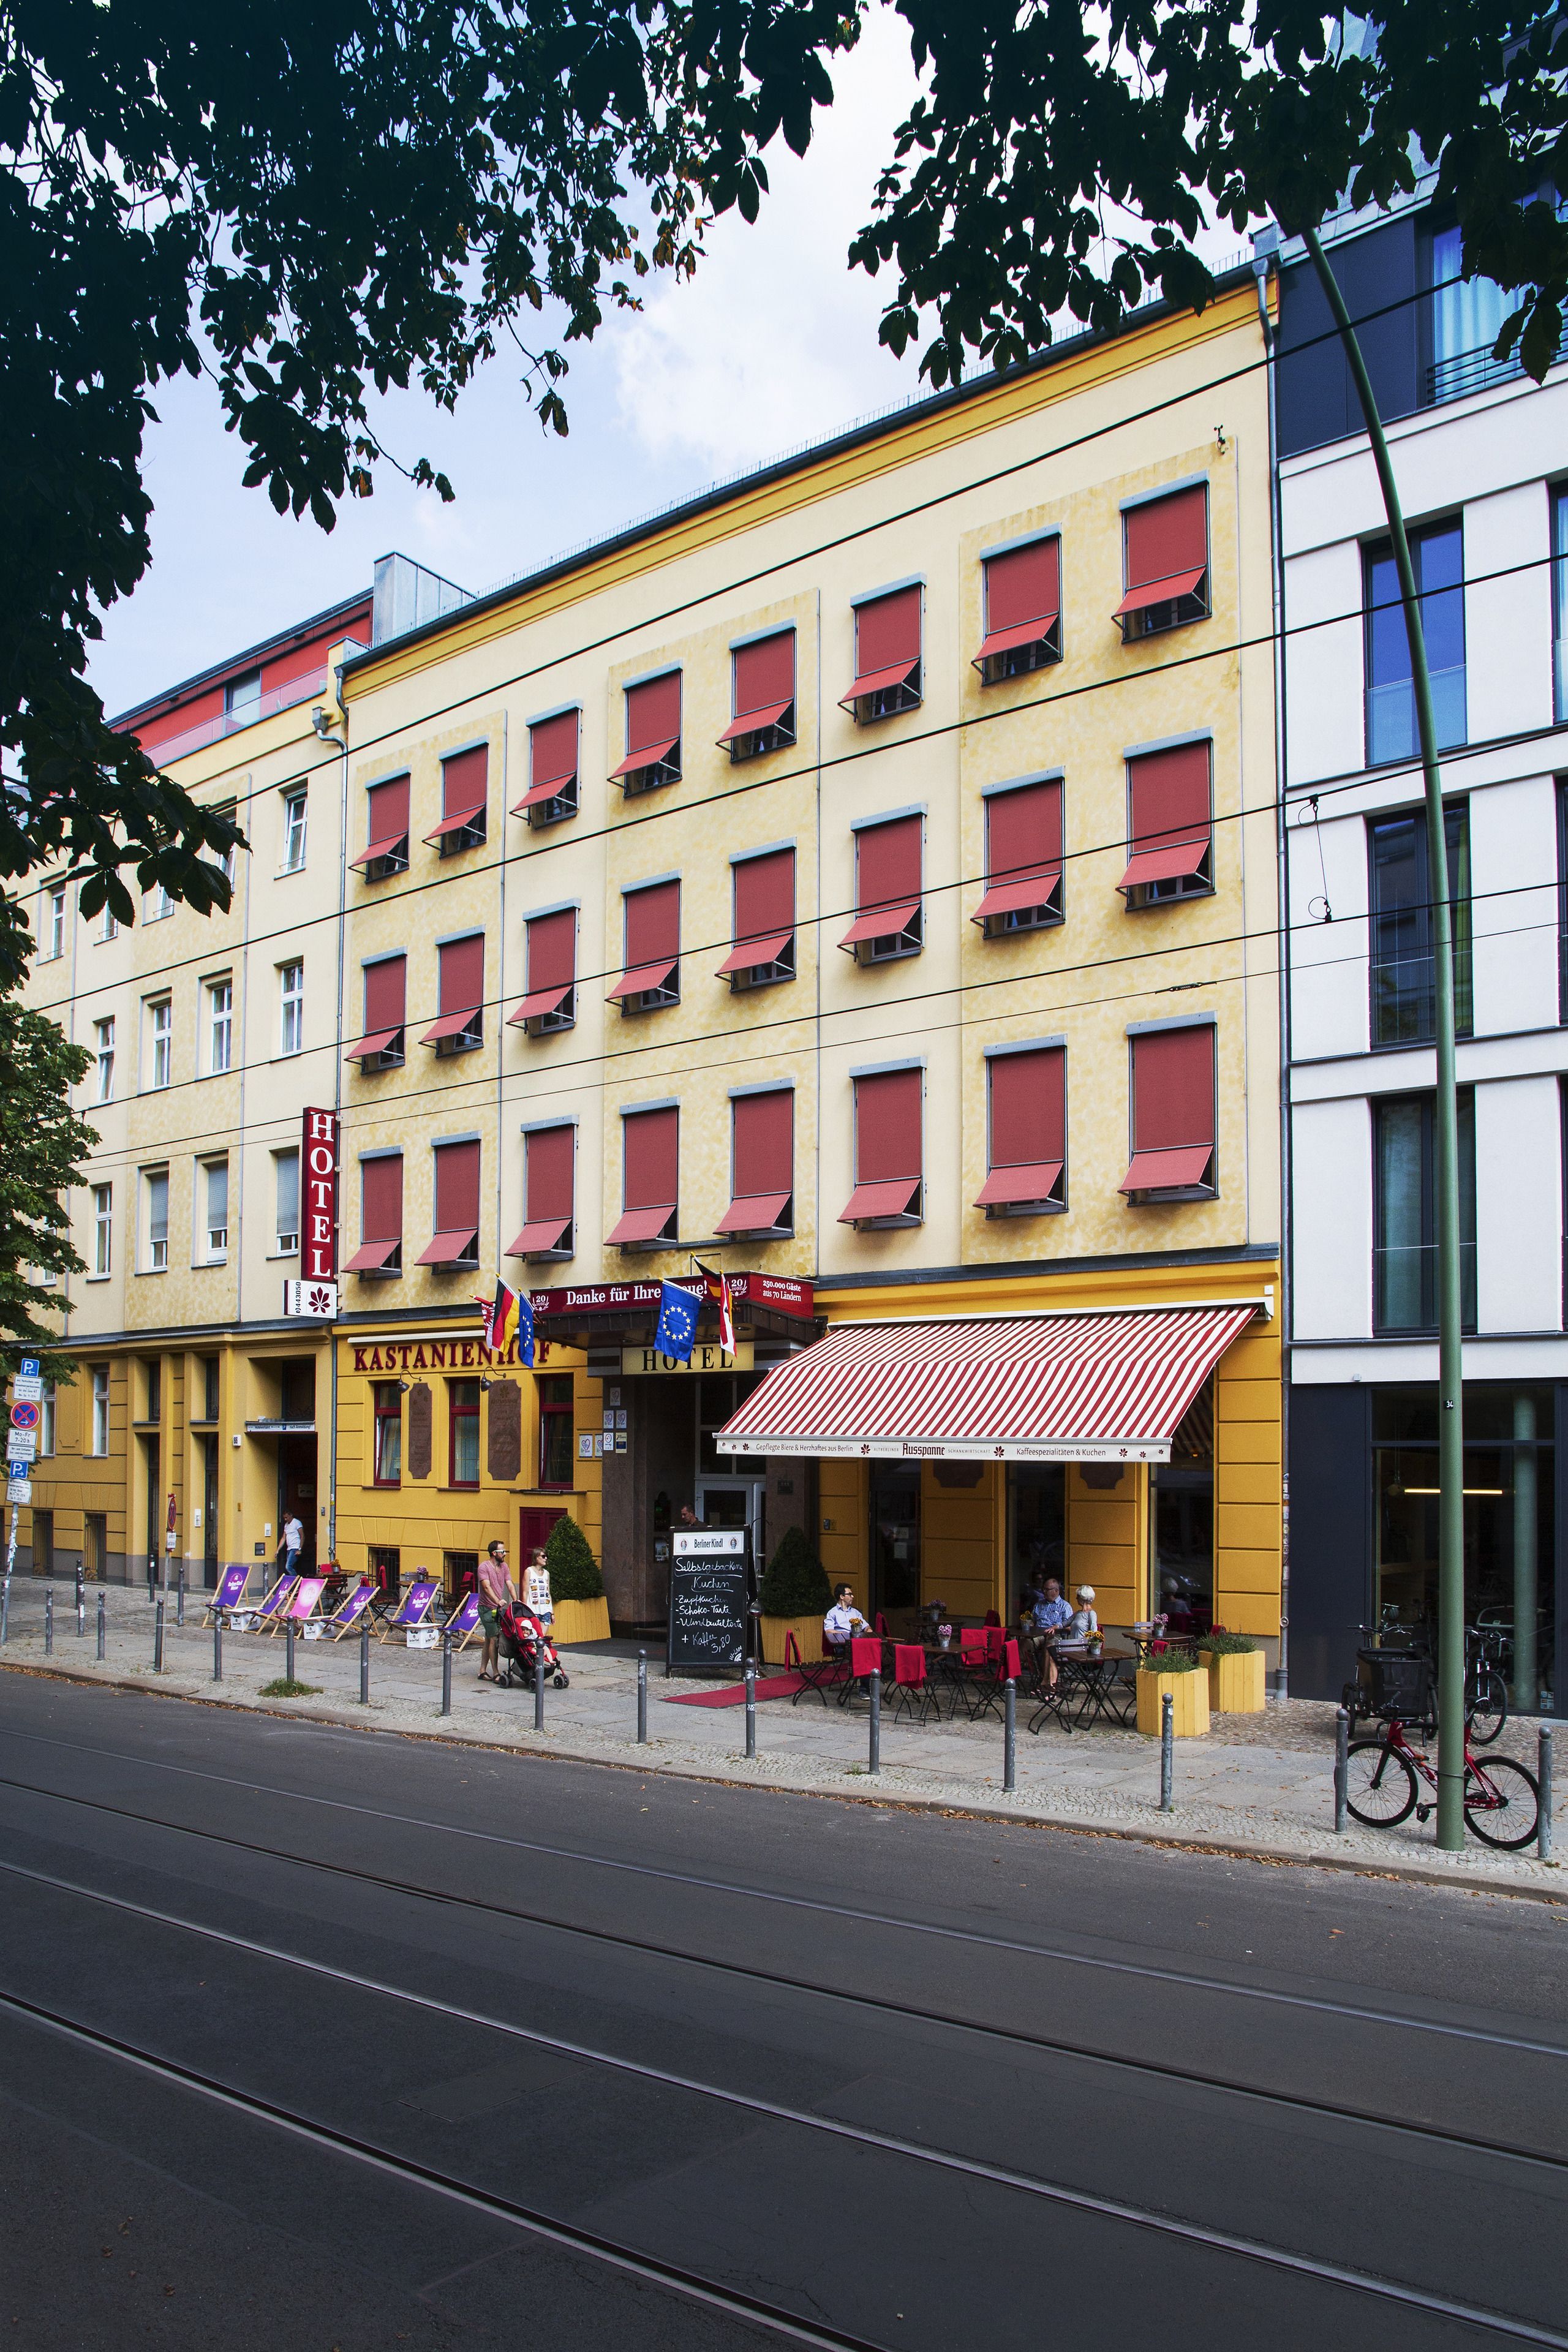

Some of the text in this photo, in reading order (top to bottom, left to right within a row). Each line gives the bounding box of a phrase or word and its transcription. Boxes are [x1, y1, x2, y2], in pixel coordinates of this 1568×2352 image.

[309, 1111, 334, 1277] HOTEL
[763, 1280, 801, 1292] 250.000 Gäste
[567, 1289, 606, 1305] Danke
[609, 1287, 630, 1302] für
[633, 1285, 662, 1300] Ihre
[780, 1291, 801, 1302] Ländern
[23, 1361, 34, 1374] P
[756, 1443, 780, 1452] Gepflegte
[902, 1442, 945, 1457] Ausspanne
[1016, 1447, 1074, 1457] Kaffeespezialitäten
[13, 1463, 23, 1476] P
[694, 1538, 723, 1548] Berliner Kindl
[693, 1575, 729, 1588] Kuchen
